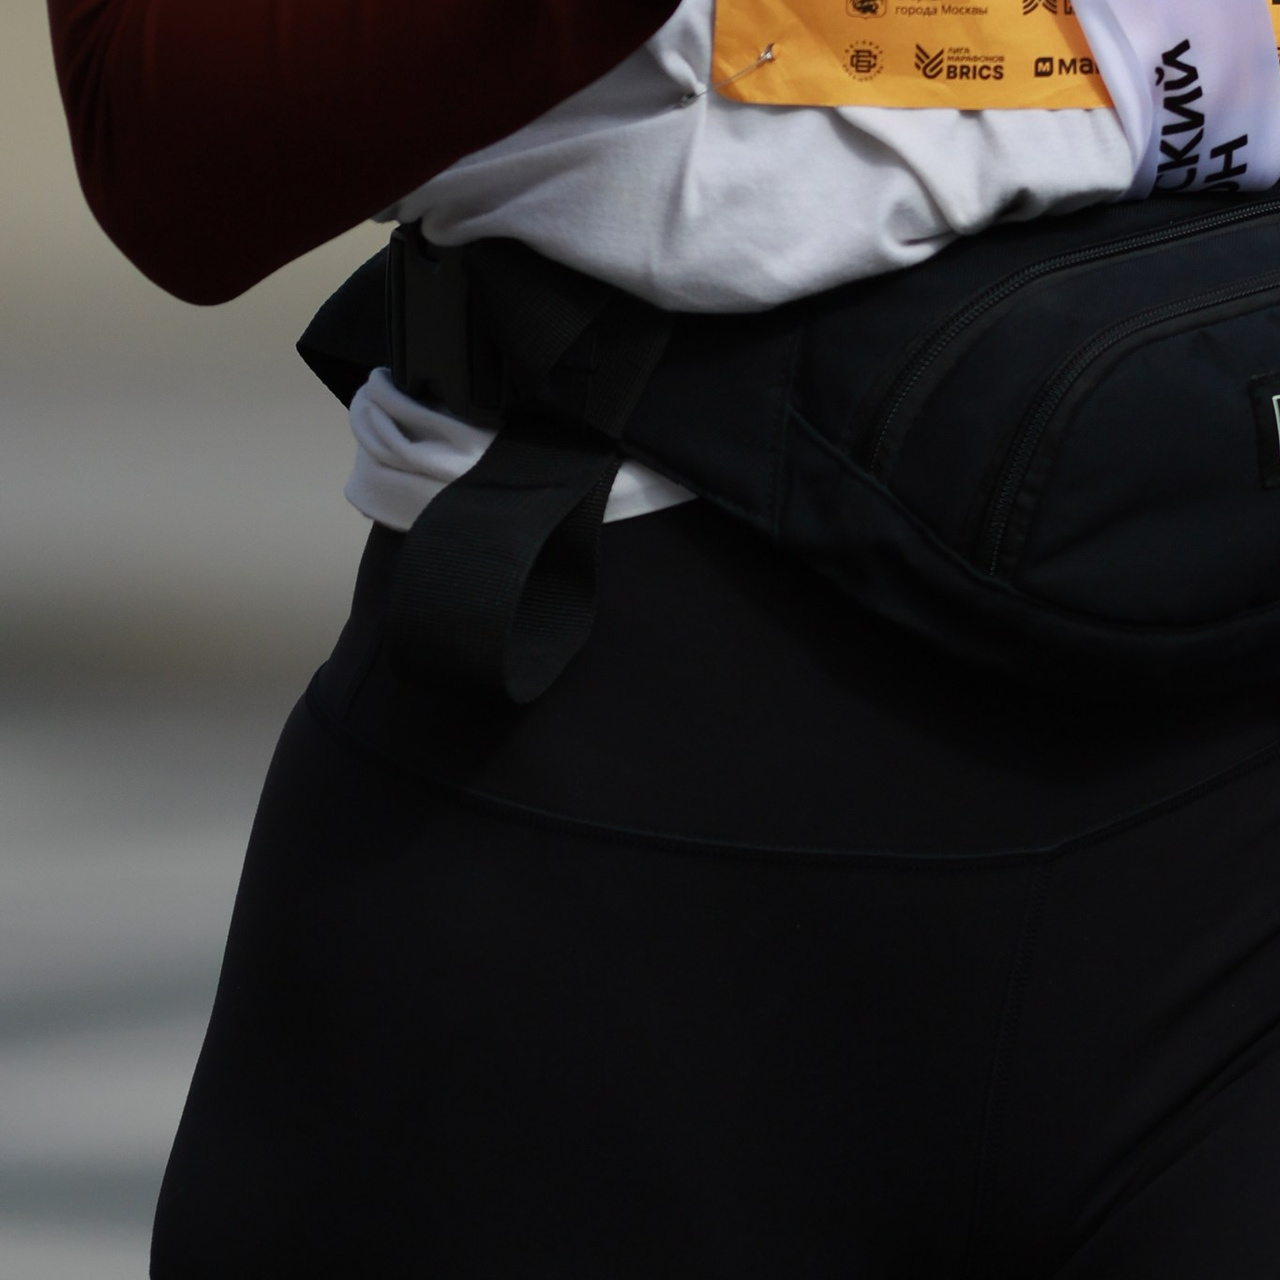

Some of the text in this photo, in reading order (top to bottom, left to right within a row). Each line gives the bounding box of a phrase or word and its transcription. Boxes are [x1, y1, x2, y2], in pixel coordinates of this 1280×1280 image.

[895, 5, 988, 17] города Москвы
[946, 65, 1004, 80] BRICS
